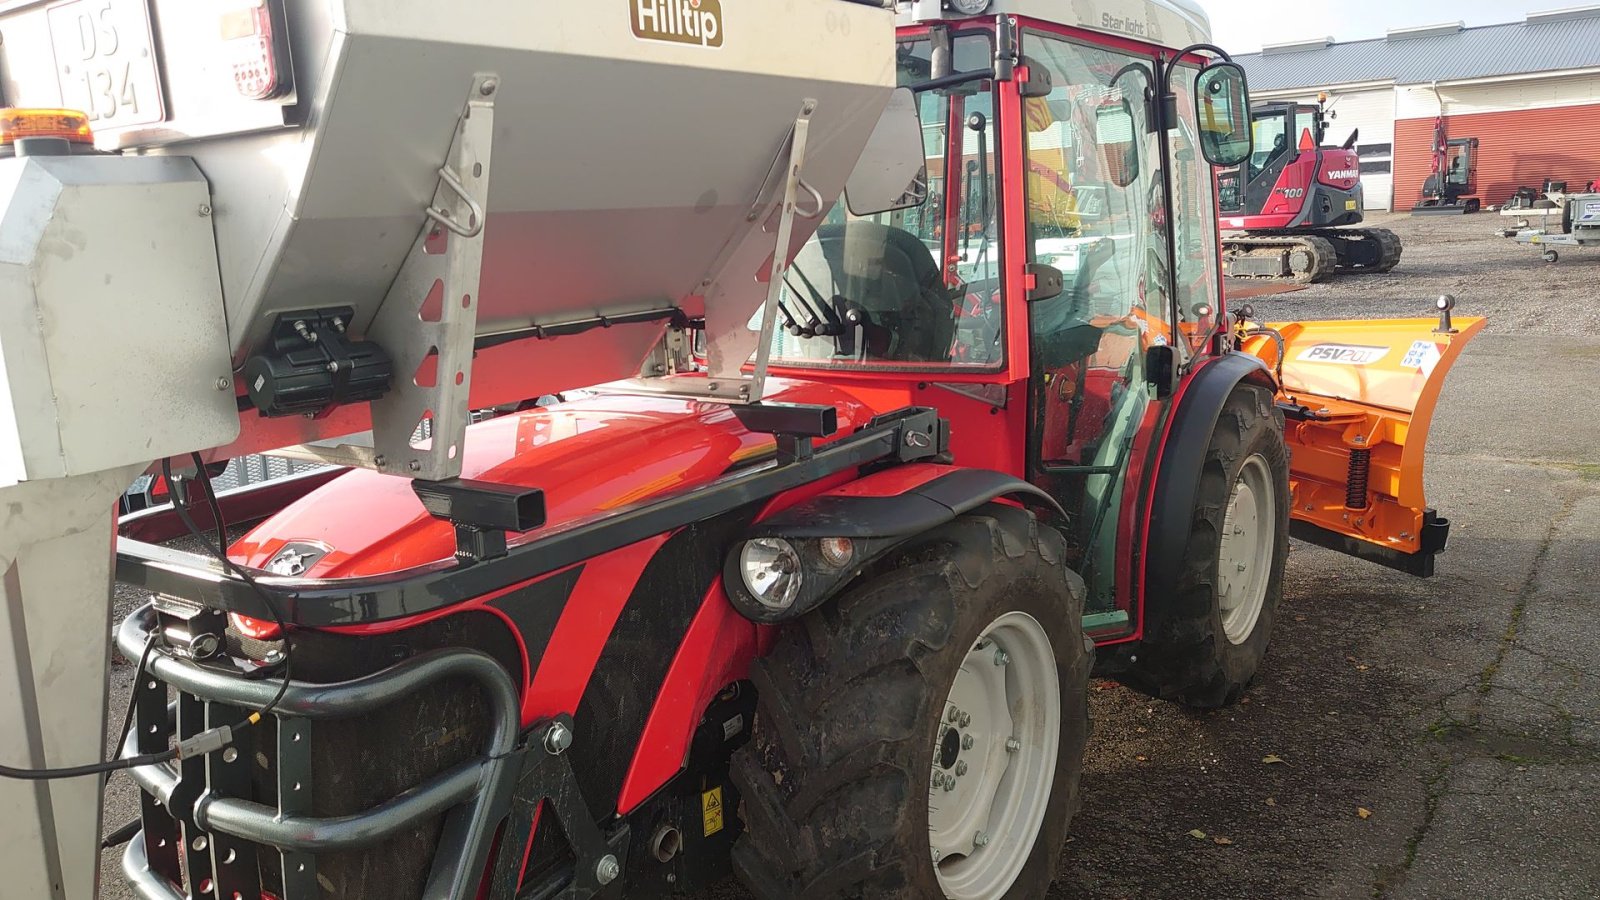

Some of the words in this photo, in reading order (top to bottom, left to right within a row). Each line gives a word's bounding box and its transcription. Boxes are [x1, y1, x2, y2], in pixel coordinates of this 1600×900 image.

[79, 1, 119, 61] DS
[638, 0, 717, 46] Hilltip
[1102, 12, 1125, 29] Star
[1125, 18, 1144, 35] light
[81, 61, 139, 122] 134
